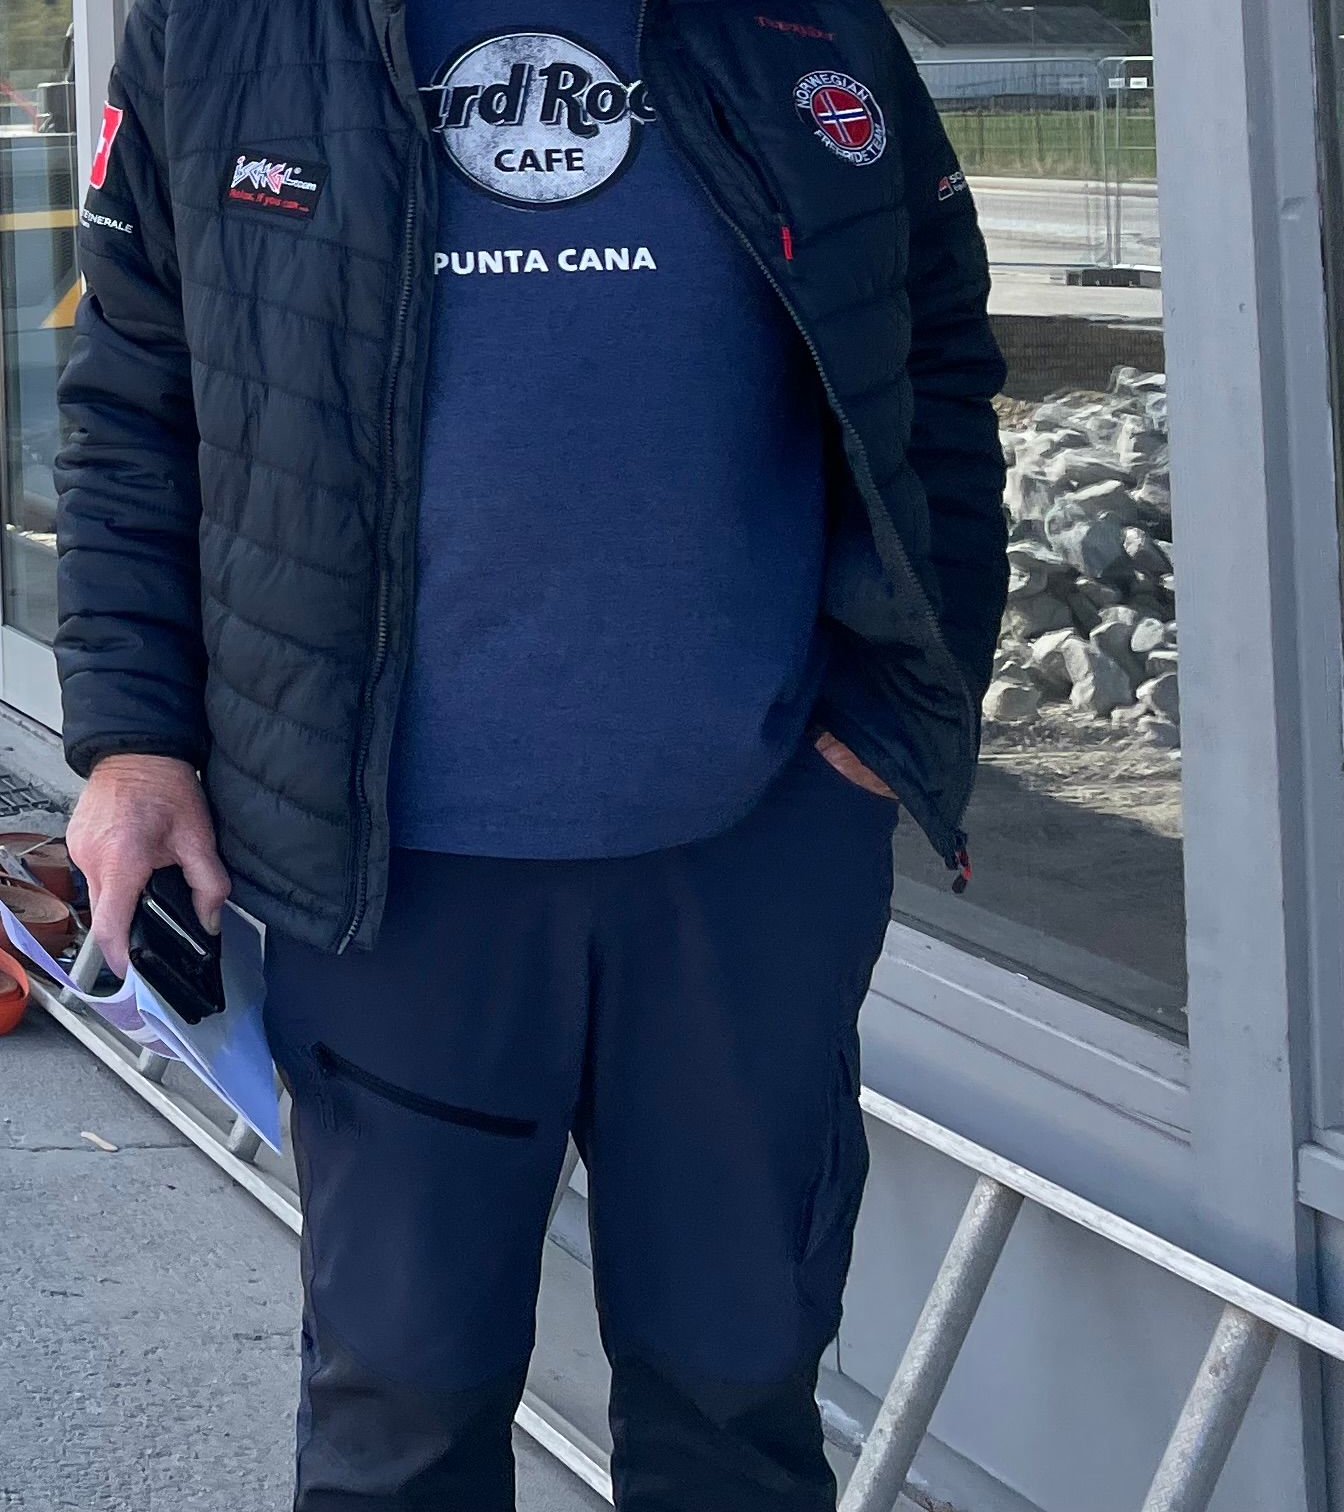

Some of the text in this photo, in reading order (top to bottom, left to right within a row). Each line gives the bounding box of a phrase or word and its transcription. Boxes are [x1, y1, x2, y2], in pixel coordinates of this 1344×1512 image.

[539, 62, 658, 139] Roc
[796, 73, 869, 109] NORWEGIAN
[868, 123, 886, 156] TEAM
[494, 148, 585, 172] CAFE
[434, 247, 658, 275] PUNTA CANA
